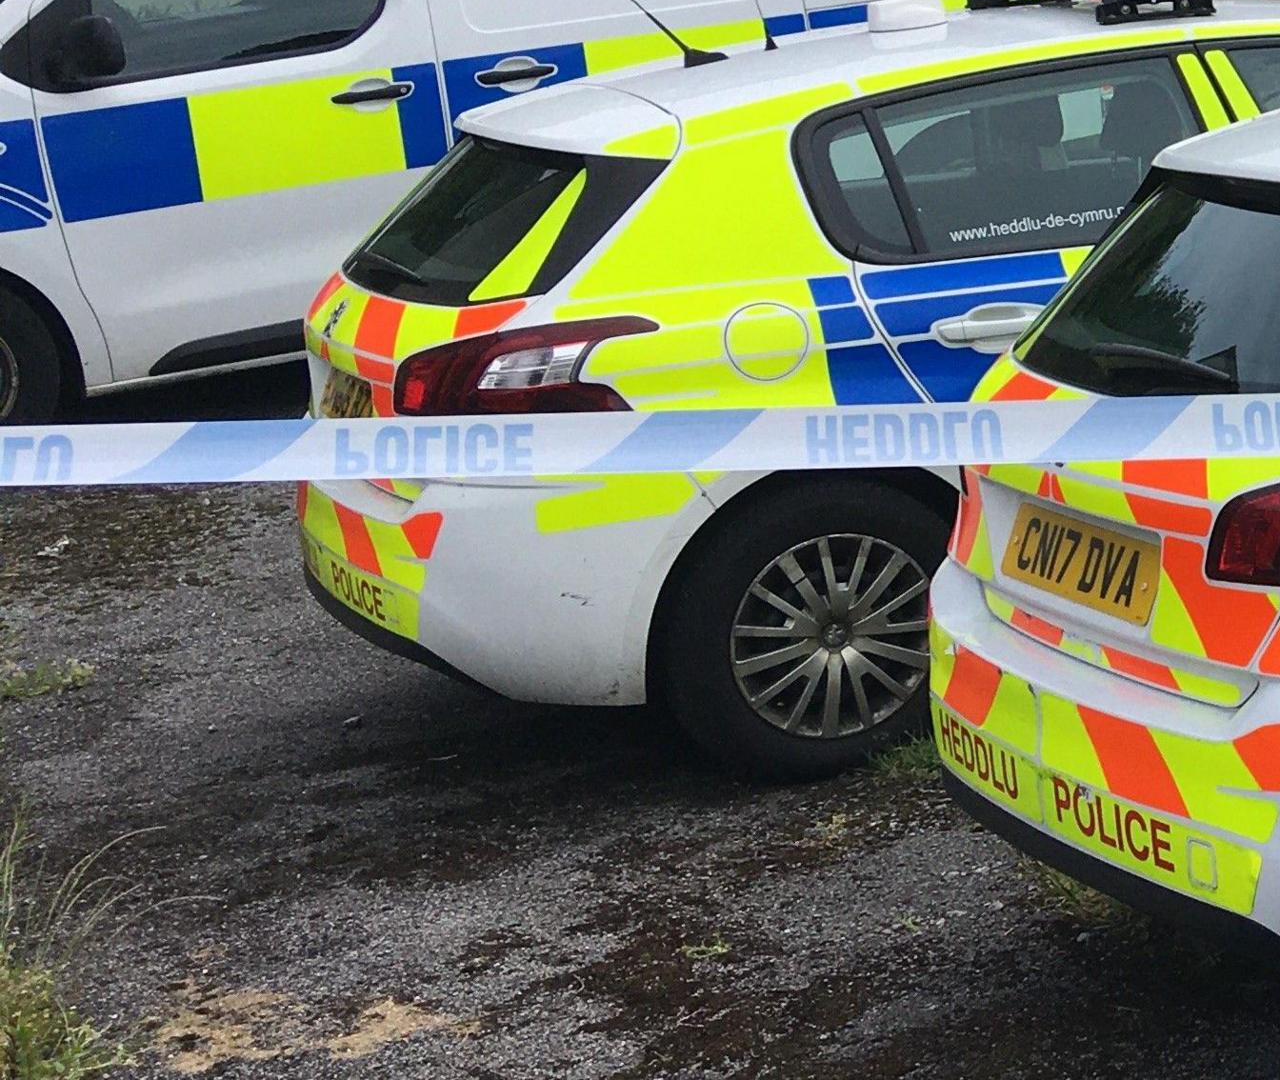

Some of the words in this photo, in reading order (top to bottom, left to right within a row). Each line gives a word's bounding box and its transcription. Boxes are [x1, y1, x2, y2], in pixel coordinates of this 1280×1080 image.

[331, 560, 386, 621] POLICE
[1017, 517, 1080, 584] CN17
[1077, 538, 1140, 608] DVA
[939, 709, 1018, 799] HEDDLU
[1052, 776, 1175, 872] POLICE
